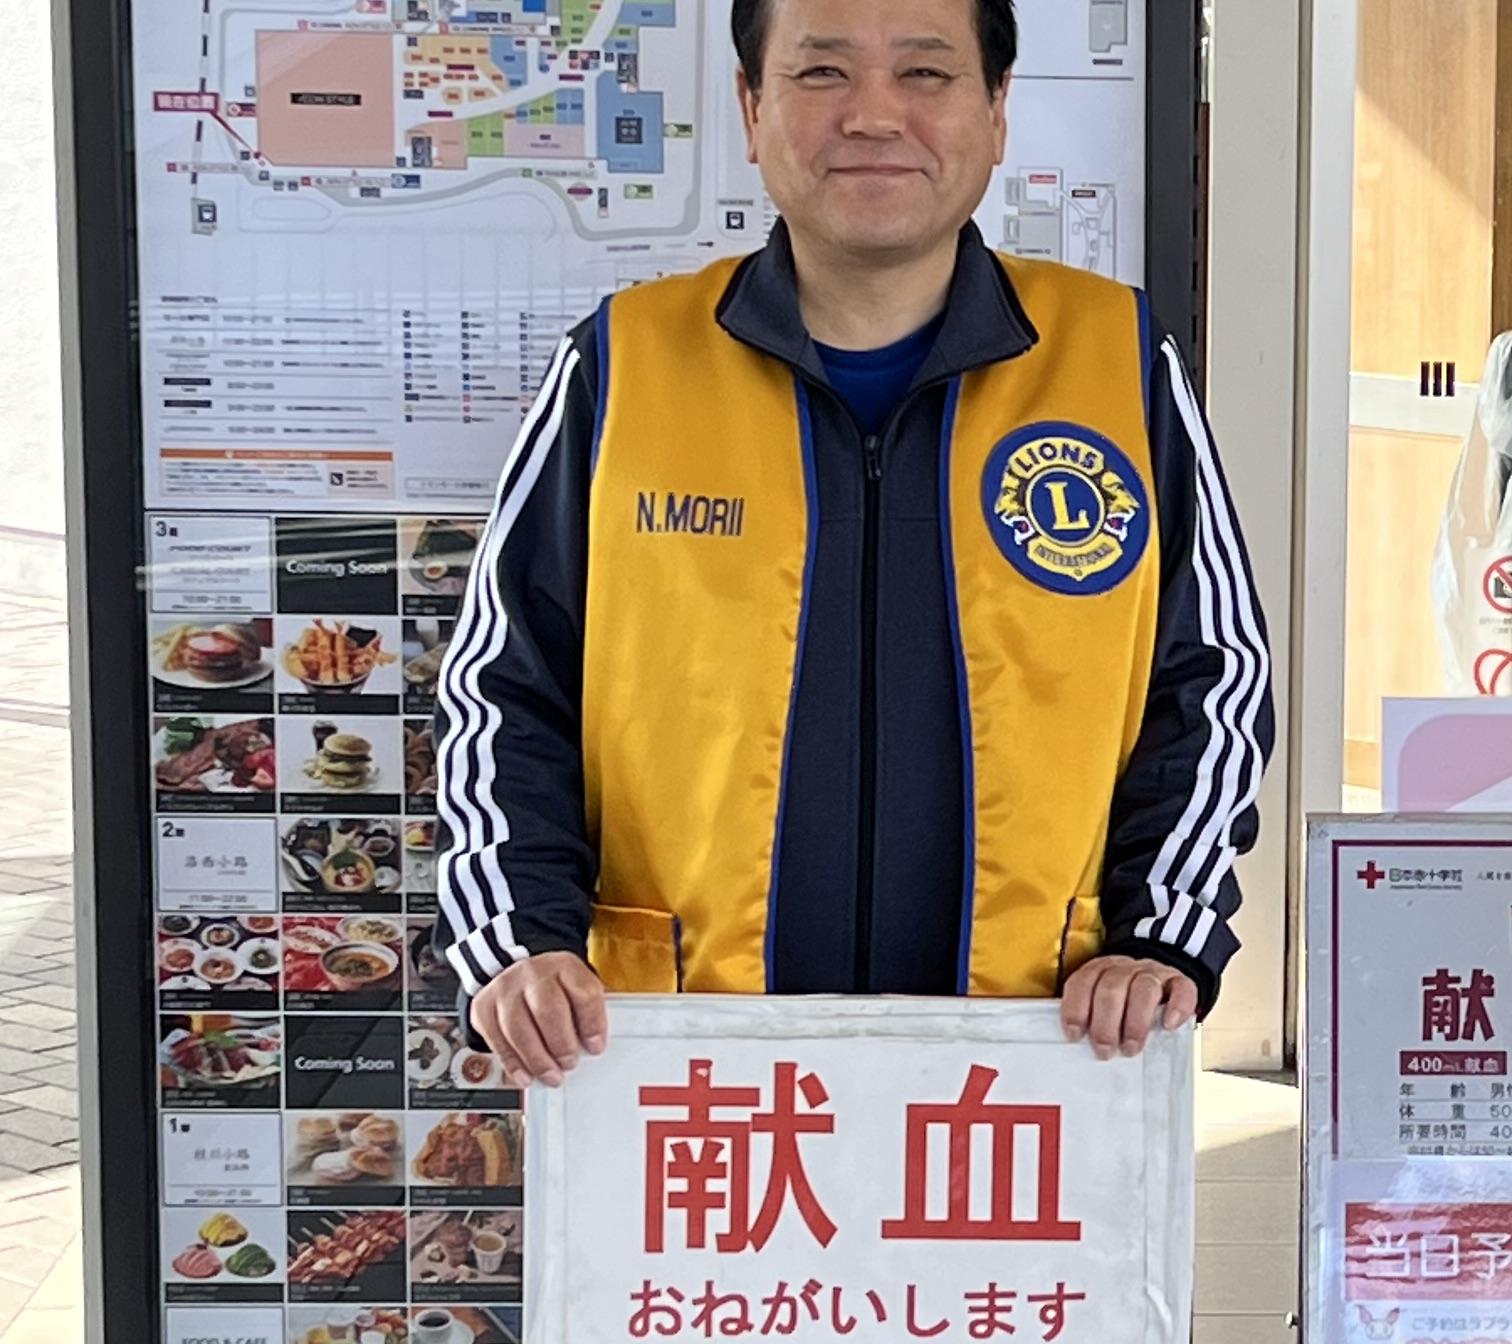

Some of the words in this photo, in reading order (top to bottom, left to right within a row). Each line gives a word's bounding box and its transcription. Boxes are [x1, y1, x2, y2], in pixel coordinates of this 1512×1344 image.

[1018, 442, 1098, 474] LIONS
[636, 491, 745, 537] N.MORII
[1045, 481, 1090, 530] L
[286, 560, 345, 577] Coming
[348, 561, 388, 575] Soon
[295, 1056, 353, 1073] Coming
[355, 1057, 395, 1071] Soon
[639, 1058, 1082, 1254] 献血
[628, 1277, 1087, 1342] おねがいします
